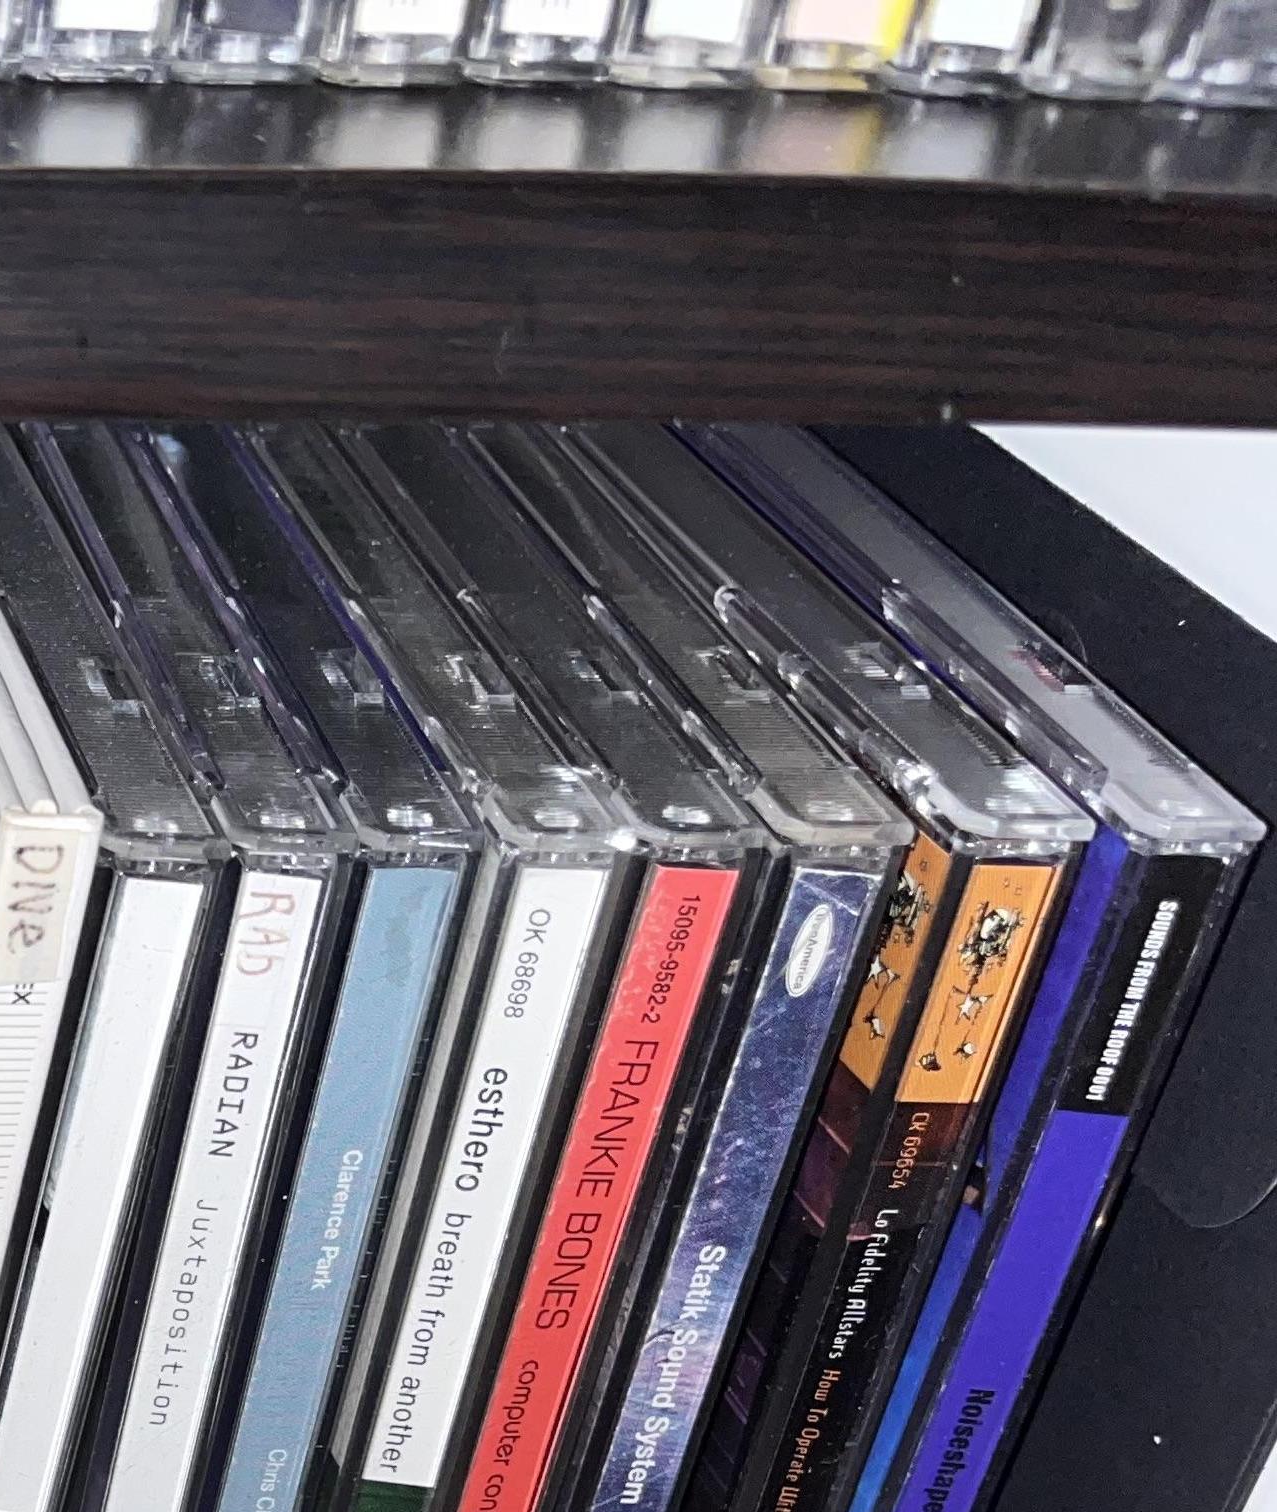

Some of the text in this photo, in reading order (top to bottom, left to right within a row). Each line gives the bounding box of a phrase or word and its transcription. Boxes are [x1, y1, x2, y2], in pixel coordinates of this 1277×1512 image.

[503, 907, 552, 1019] OK 68698
[640, 895, 702, 1024] 15095-9582-2
[1099, 900, 1180, 1066] SOUNDS FROM THE ROOF
[148, 1031, 260, 1426] RADIAN Juxtaposition
[310, 1149, 364, 1291] Clarence Park
[534, 1039, 660, 1330] FRANKIE BONES
[379, 1067, 509, 1473] esthero breath from another
[828, 1232, 890, 1360] Fidelity Allstars
[492, 1359, 540, 1467] computer
[619, 1242, 731, 1505] Statik Sound System
[785, 1369, 842, 1483] How Operate
[259, 1448, 289, 1493] Chris
